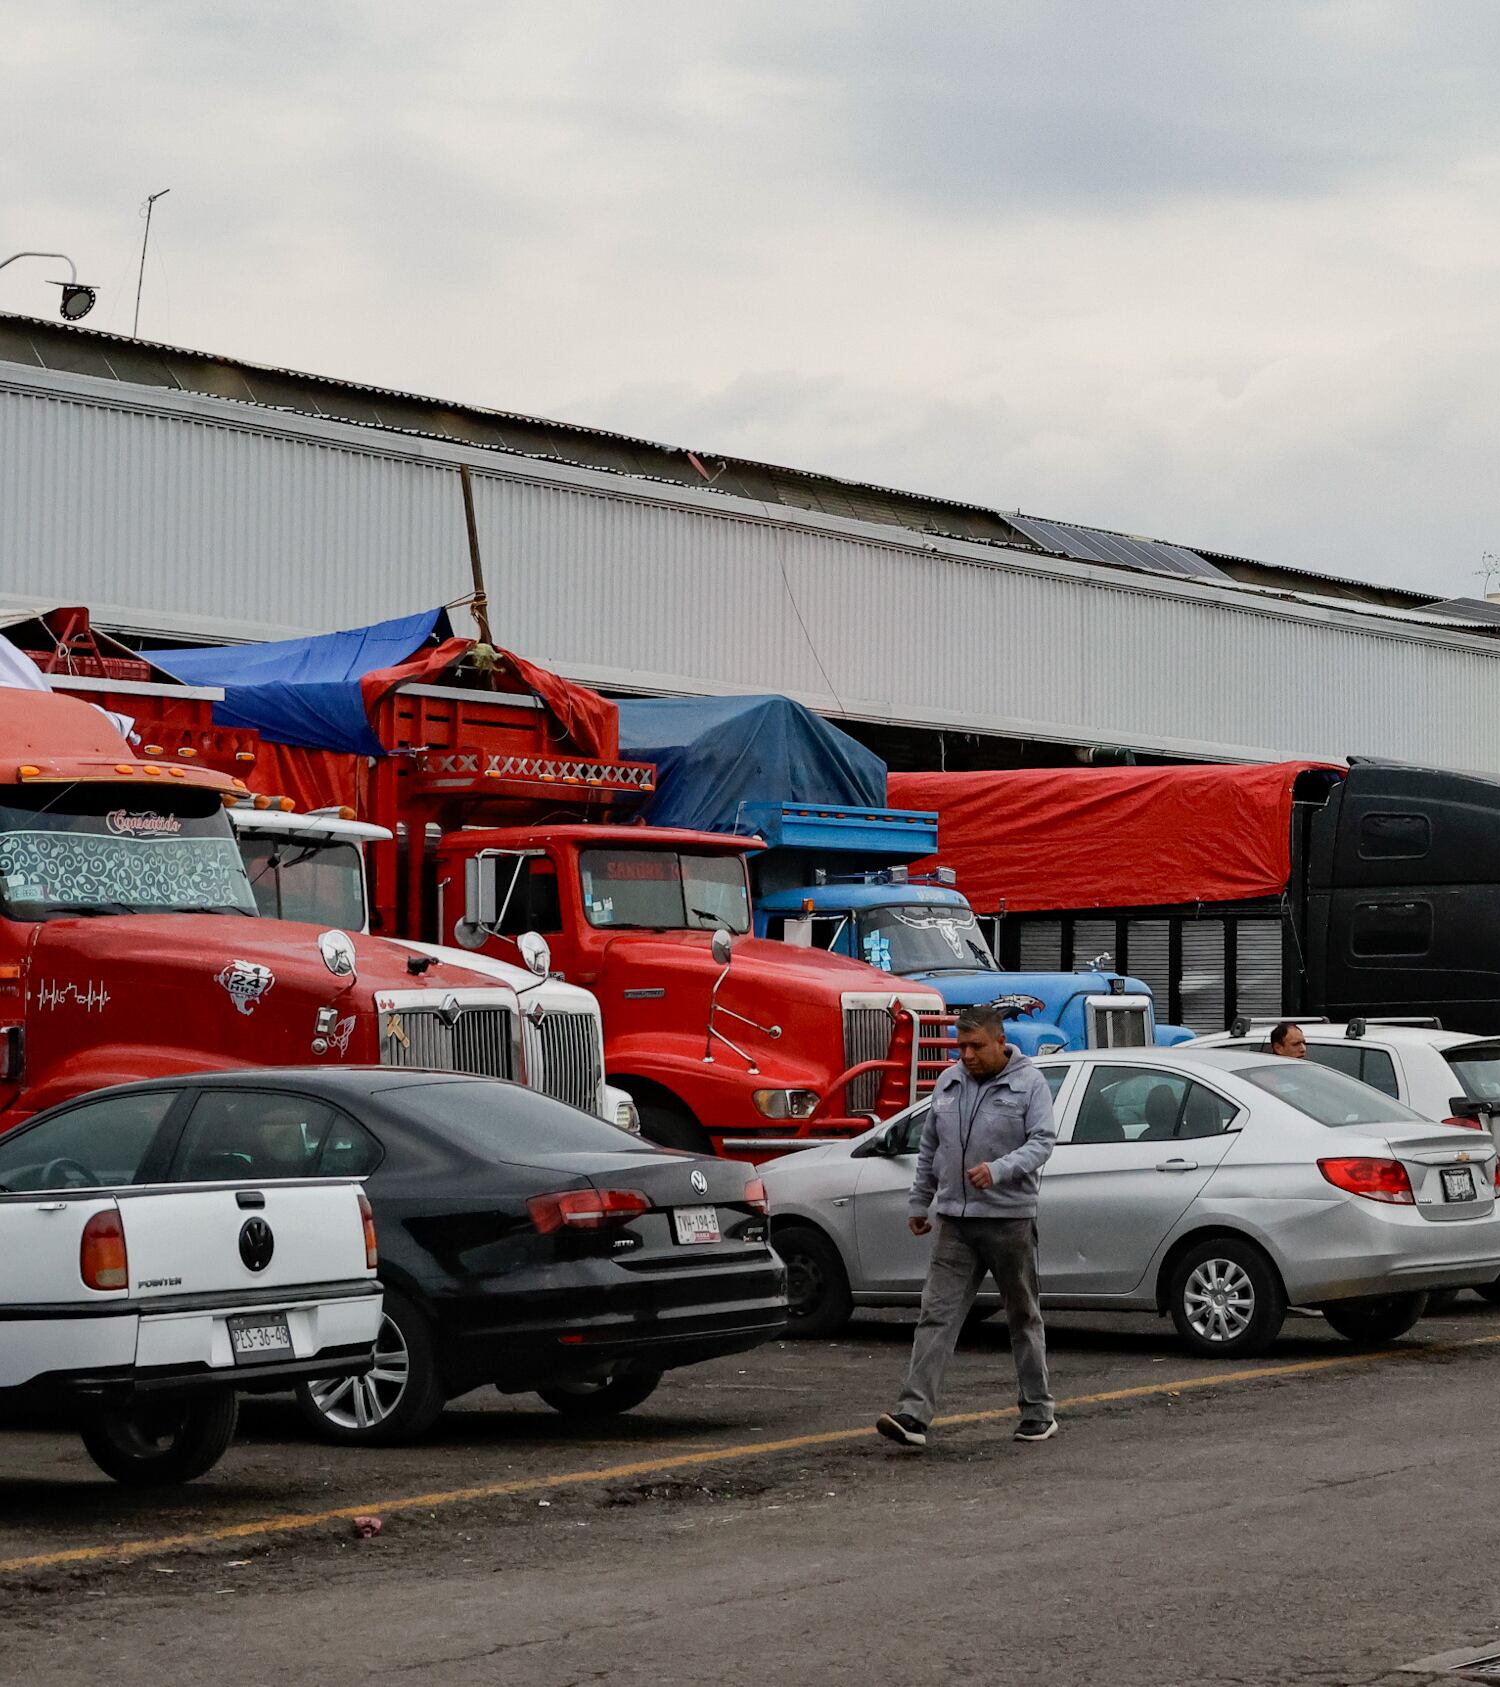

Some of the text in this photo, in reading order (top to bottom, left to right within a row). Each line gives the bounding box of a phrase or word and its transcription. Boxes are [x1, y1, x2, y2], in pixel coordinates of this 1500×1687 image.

[231, 974, 261, 988] 24
[230, 985, 258, 995] HRS
[138, 1278, 182, 1288] POINTER
[233, 1326, 290, 1350] PES-36-48
